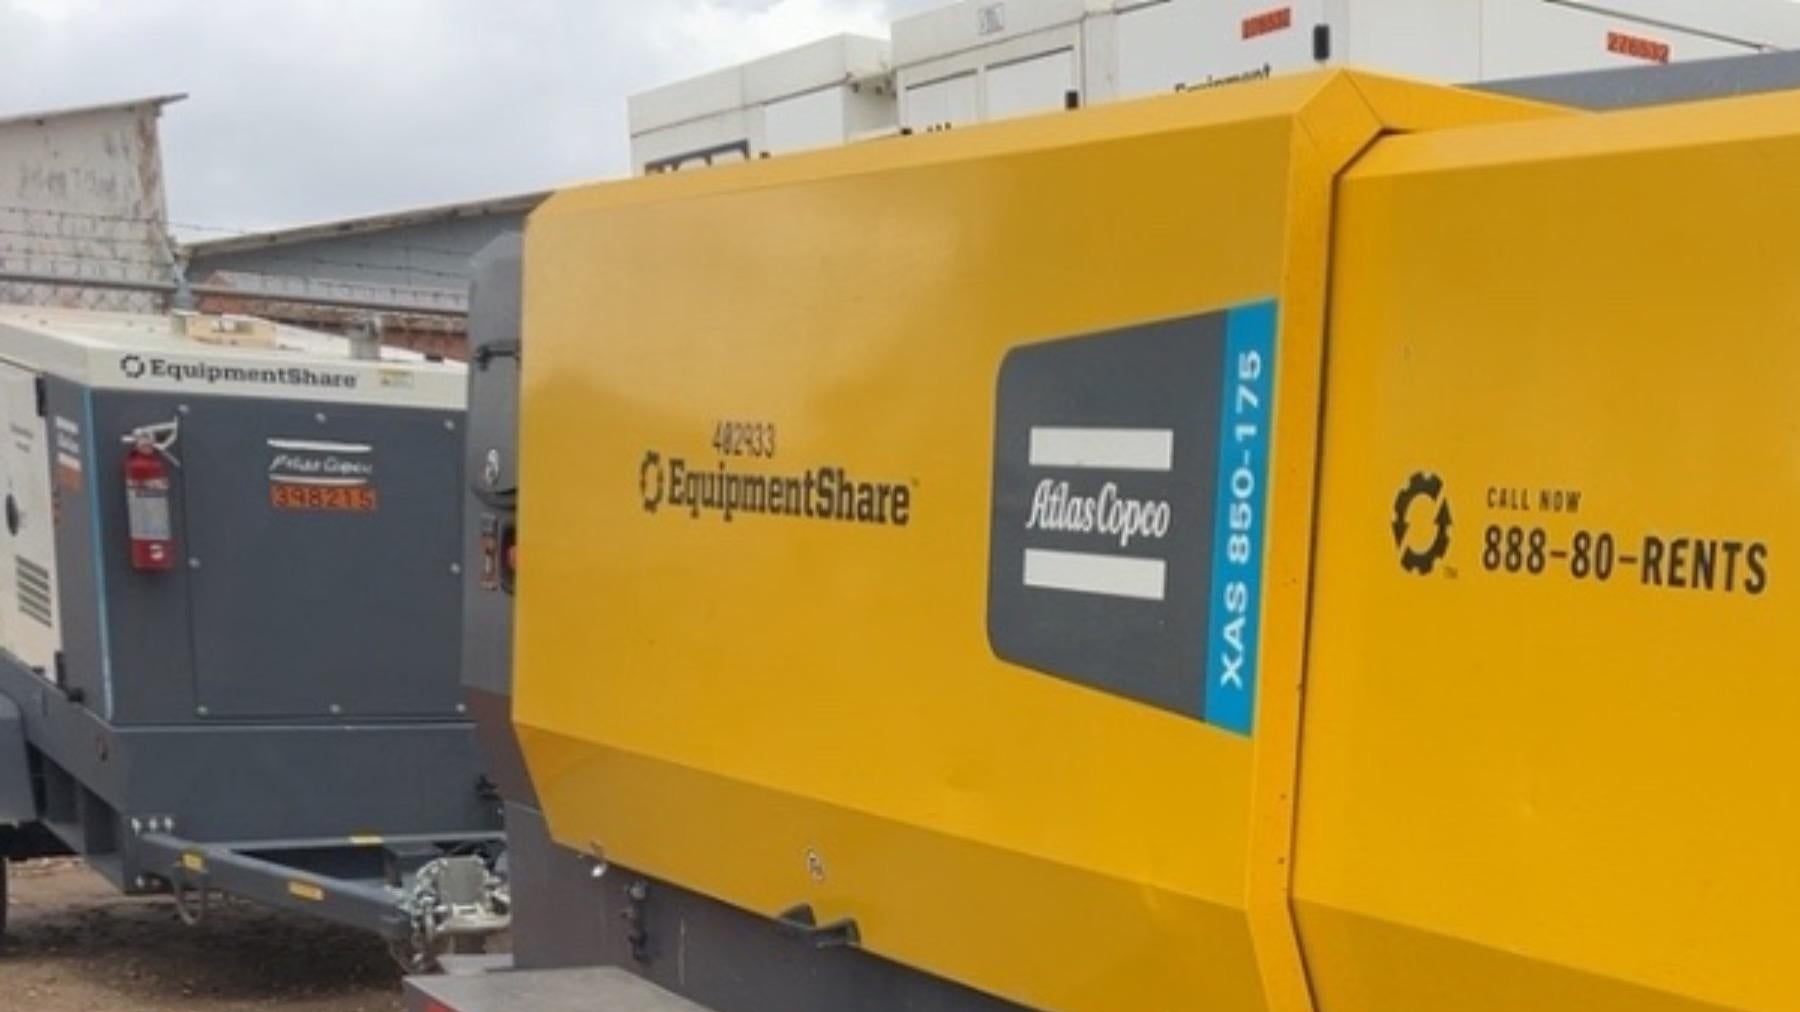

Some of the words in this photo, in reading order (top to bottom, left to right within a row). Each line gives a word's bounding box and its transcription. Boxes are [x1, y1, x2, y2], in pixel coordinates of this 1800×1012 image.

[150, 358, 358, 389] EquipmentShare
[713, 421, 776, 458] 402933
[1227, 350, 1261, 565] 850-175
[667, 457, 910, 526] EquipmentShare
[1026, 479, 1093, 534] Atlas
[1097, 482, 1171, 547] Copco
[1486, 486, 1530, 511] CALL
[1539, 487, 1582, 513] NOW
[1482, 524, 1768, 595] 888-80-RENTS
[1219, 581, 1247, 689] XAS
